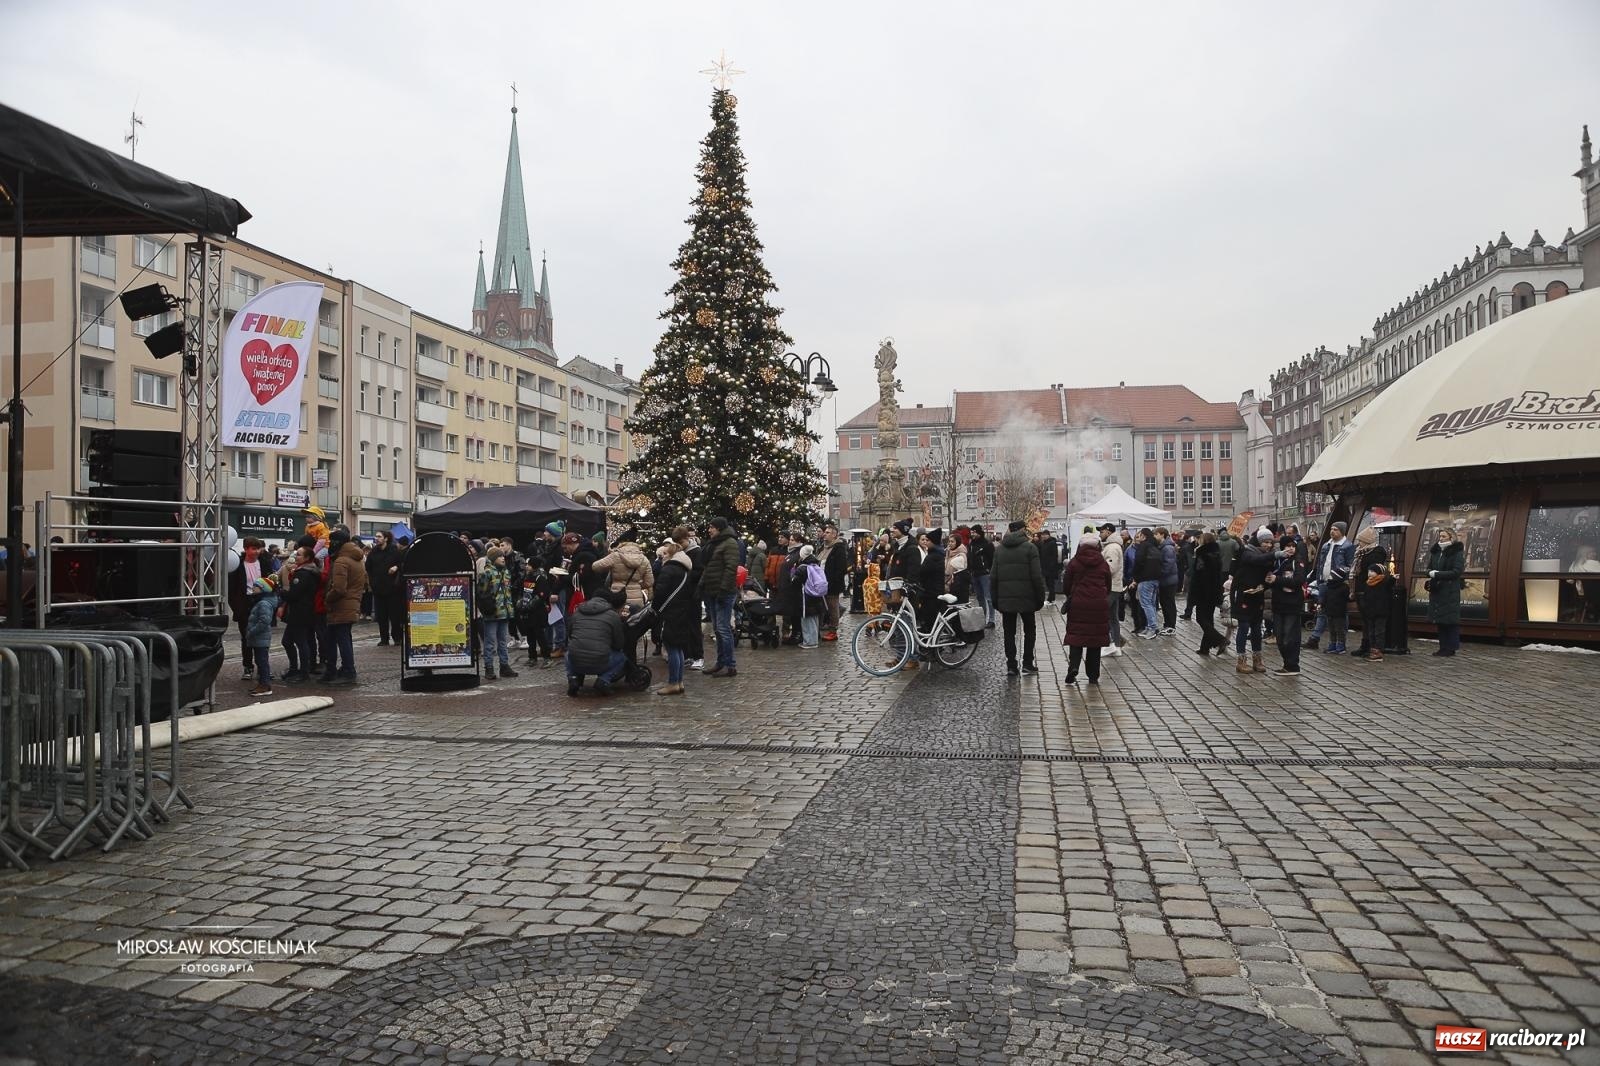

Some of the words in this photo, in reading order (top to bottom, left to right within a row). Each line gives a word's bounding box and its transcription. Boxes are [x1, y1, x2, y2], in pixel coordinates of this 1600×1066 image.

[241, 313, 307, 339] FINAŁ
[234, 410, 292, 429] SZTAB
[1418, 397, 1514, 438] aqua
[1506, 421, 1600, 431] SZYMOCIC
[234, 431, 291, 446] RACIBÓRZ
[241, 515, 294, 527] JUBILER
